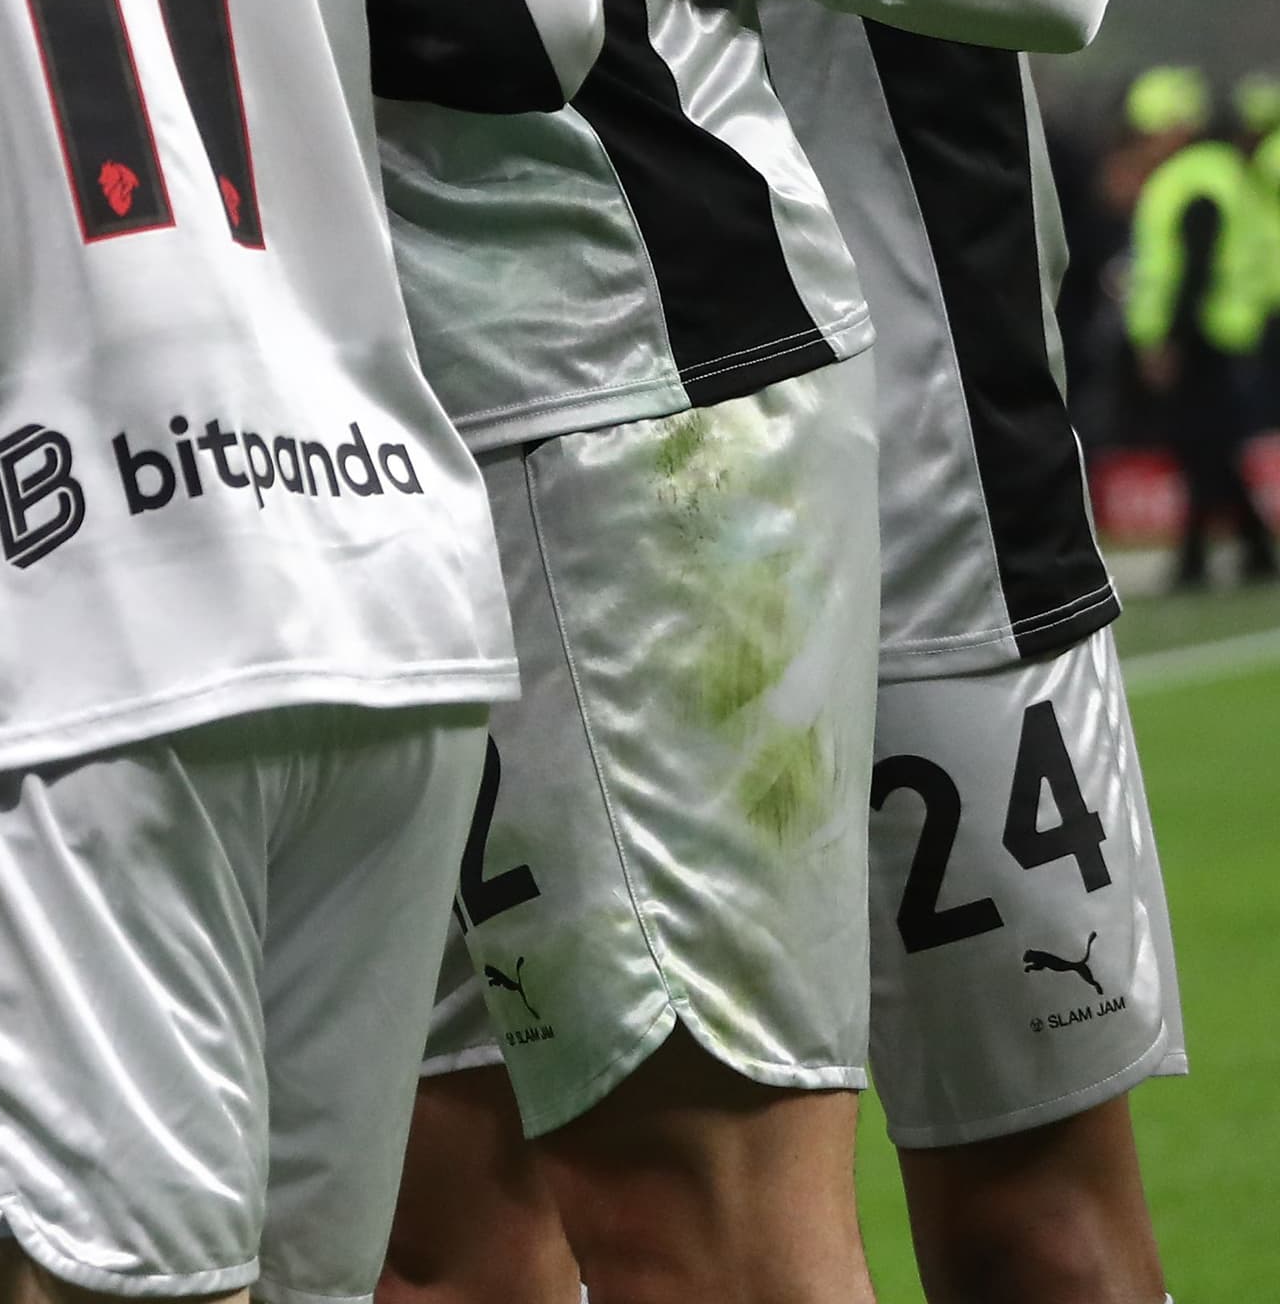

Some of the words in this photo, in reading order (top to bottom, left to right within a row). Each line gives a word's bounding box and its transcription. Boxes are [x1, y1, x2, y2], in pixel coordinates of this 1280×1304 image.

[112, 414, 425, 518] bitpanda
[453, 733, 541, 934] 2
[869, 699, 1112, 953] 24
[1048, 1005, 1093, 1029] SLAM
[1096, 996, 1127, 1017] JAM
